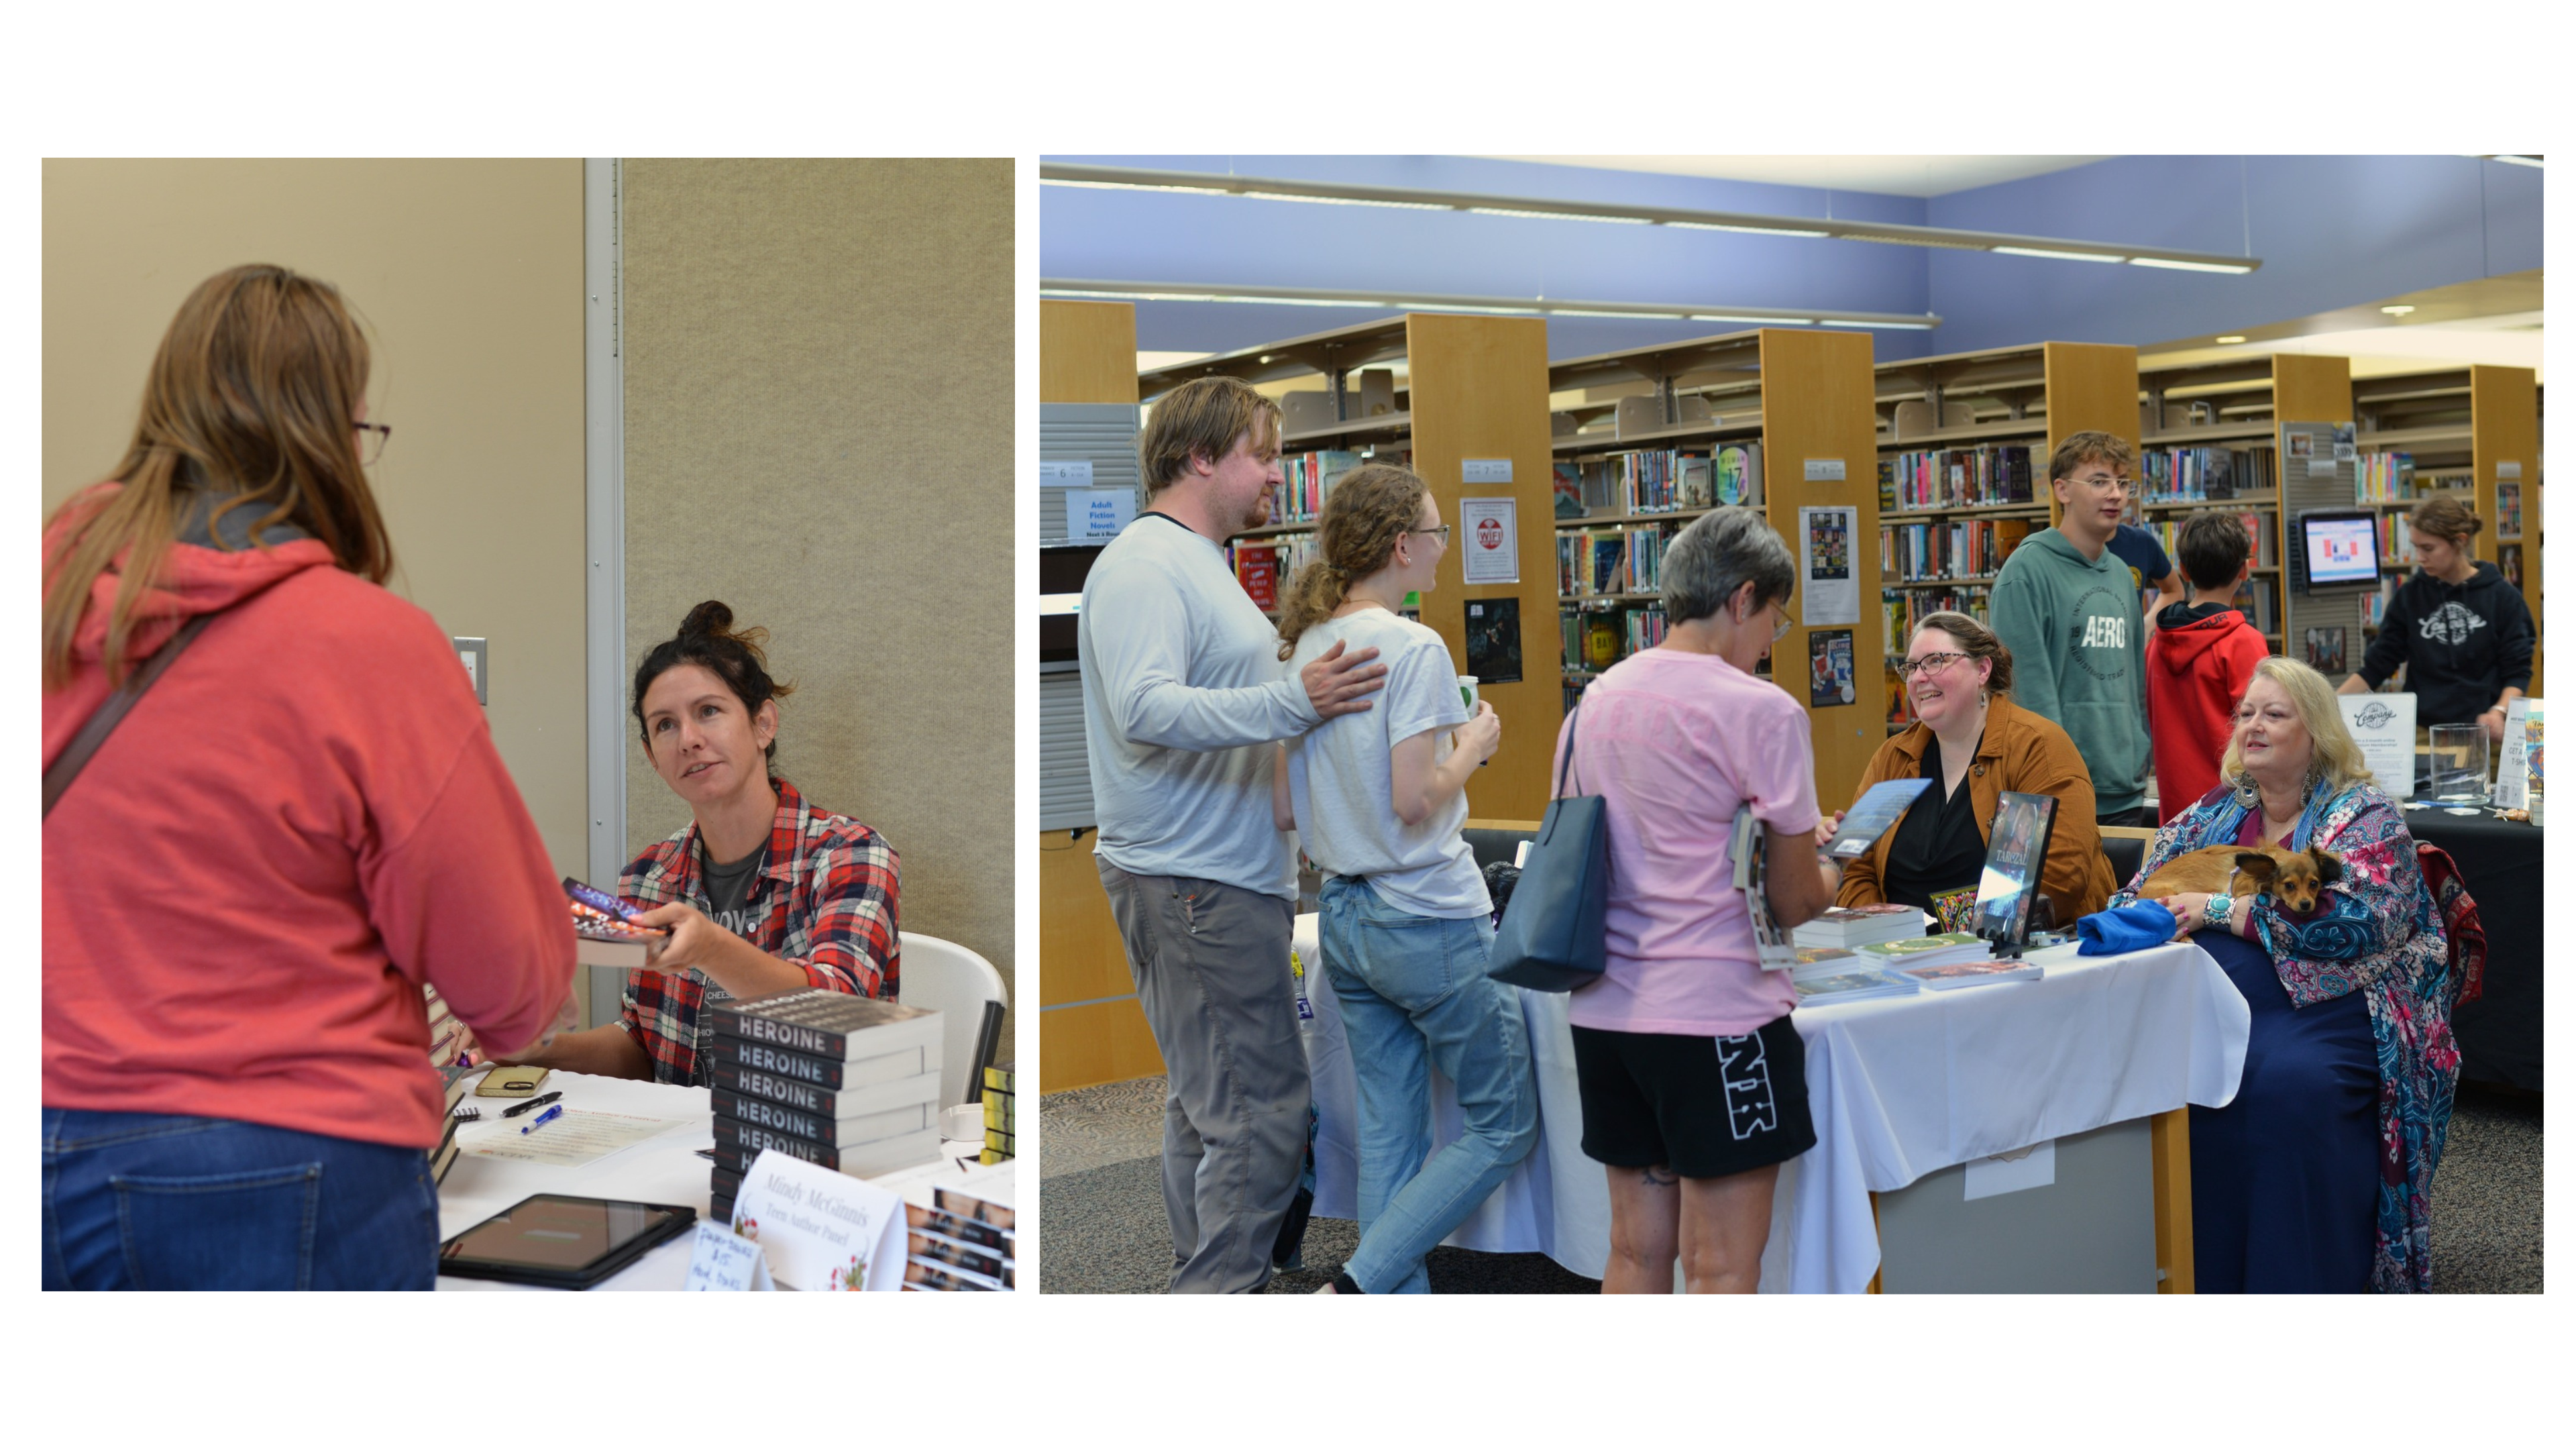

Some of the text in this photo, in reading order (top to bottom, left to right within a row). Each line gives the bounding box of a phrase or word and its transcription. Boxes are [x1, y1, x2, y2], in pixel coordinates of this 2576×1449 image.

[1060, 468, 1066, 478] 6
[1484, 466, 1489, 475] 7
[1728, 467, 1743, 490] 17
[1479, 531, 1501, 541] WIFI
[2081, 615, 2125, 649] AERO
[2354, 709, 2397, 727] Company
[2508, 747, 2518, 755] GET
[739, 1016, 826, 1053] HEROINE
[739, 1044, 823, 1081] HEROINE
[739, 1071, 818, 1109] HEROINE
[737, 1098, 816, 1138] HEROINE
[739, 1126, 820, 1165] HEROINE
[763, 1173, 869, 1228] Mindy McGinnis
[765, 1203, 851, 1247] Teen Author Panel
